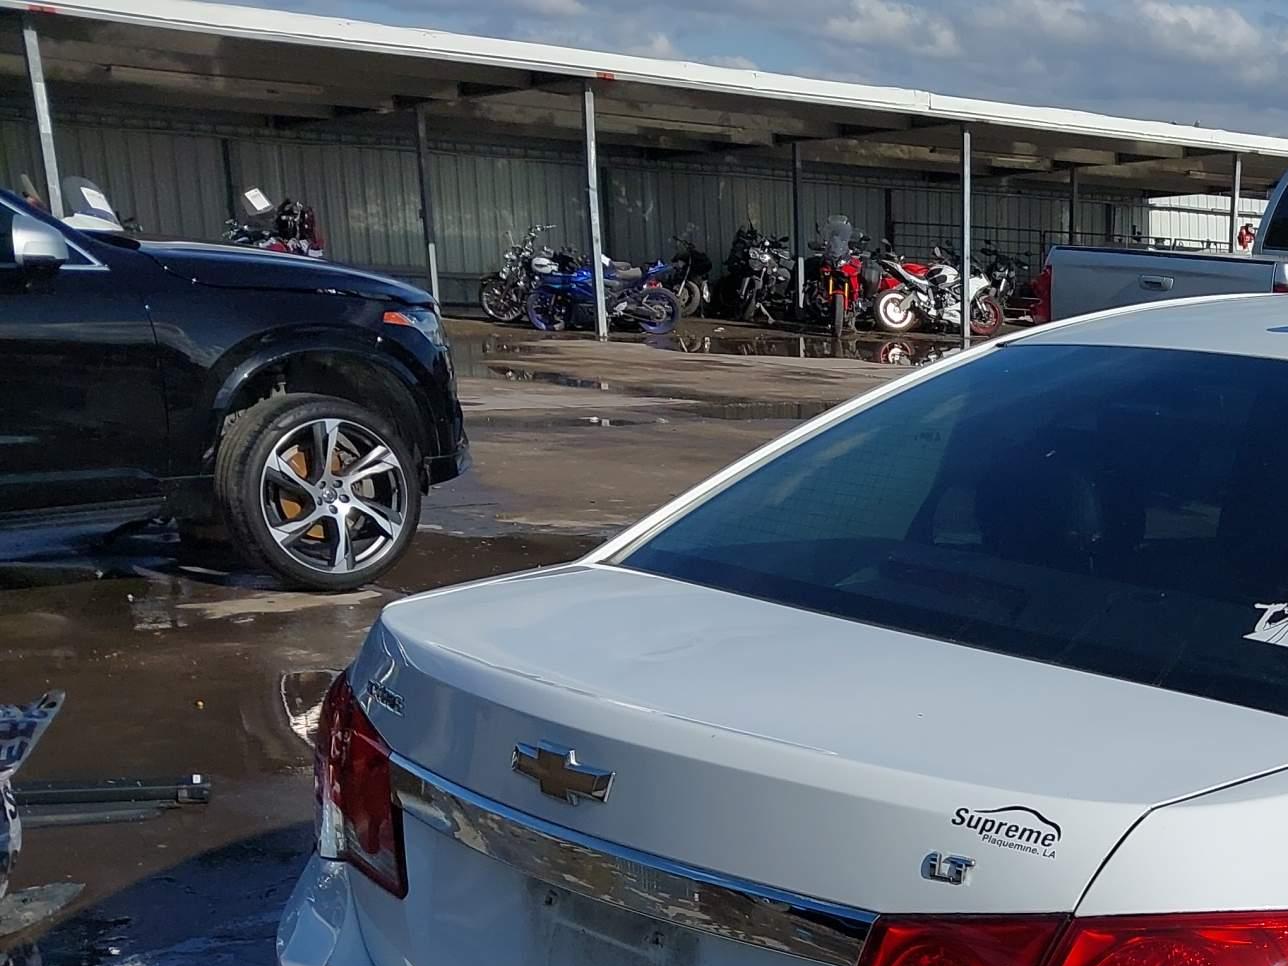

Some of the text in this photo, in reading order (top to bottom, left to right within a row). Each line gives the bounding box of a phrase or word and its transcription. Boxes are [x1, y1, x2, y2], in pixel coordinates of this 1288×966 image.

[951, 808, 1056, 847] Supreme
[921, 851, 976, 885] LT
[1042, 848, 1056, 859] LA
